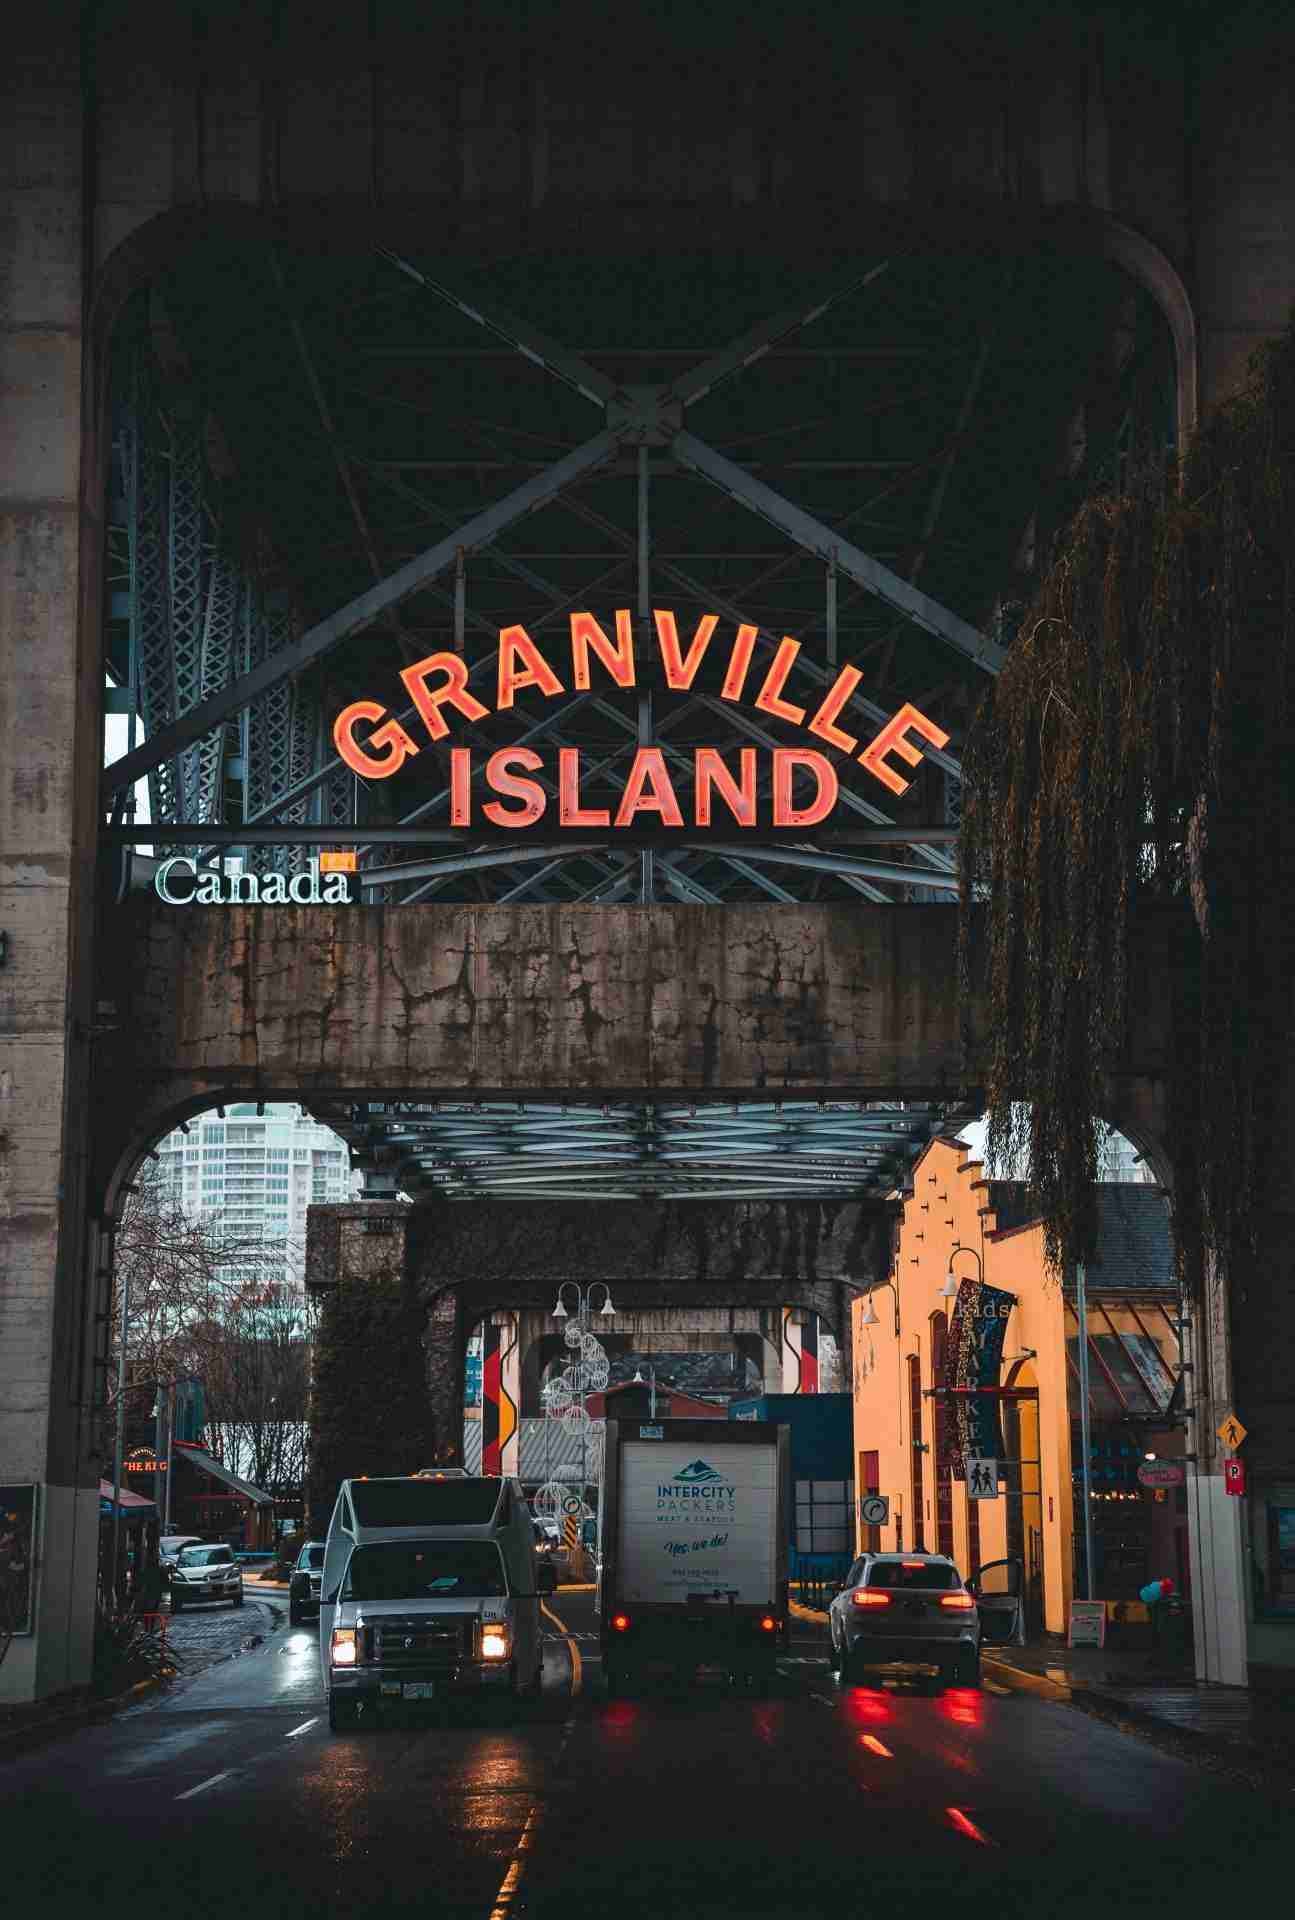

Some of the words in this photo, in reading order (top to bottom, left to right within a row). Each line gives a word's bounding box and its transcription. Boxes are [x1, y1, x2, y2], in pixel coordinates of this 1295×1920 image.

[333, 608, 951, 796] GRANVILLE
[450, 744, 840, 828] ISLAND
[154, 855, 354, 905] Canada
[656, 1500, 736, 1512] PACKERS
[657, 1486, 736, 1498] INTERCITY
